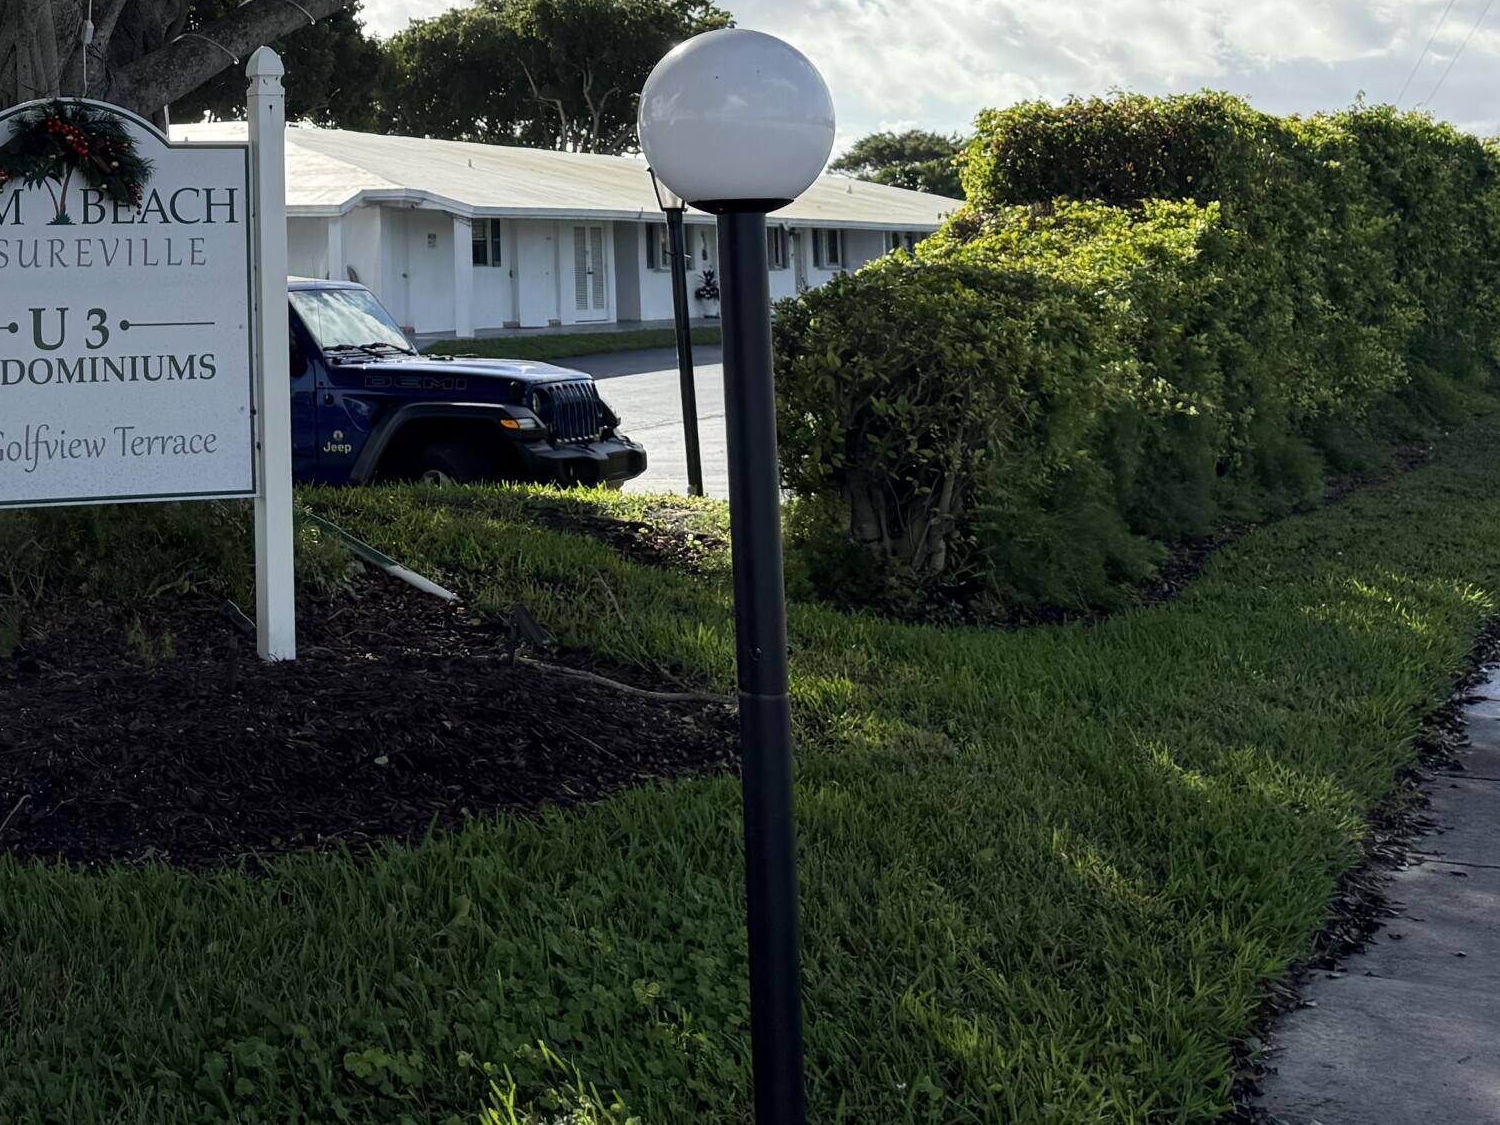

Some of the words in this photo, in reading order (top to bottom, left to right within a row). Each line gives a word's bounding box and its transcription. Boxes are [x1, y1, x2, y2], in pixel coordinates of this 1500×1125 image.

[79, 187, 239, 226] BEACH
[28, 307, 69, 351] U
[85, 307, 110, 349] 3
[113, 426, 218, 458] Terrace
[323, 441, 352, 454] Jeep
